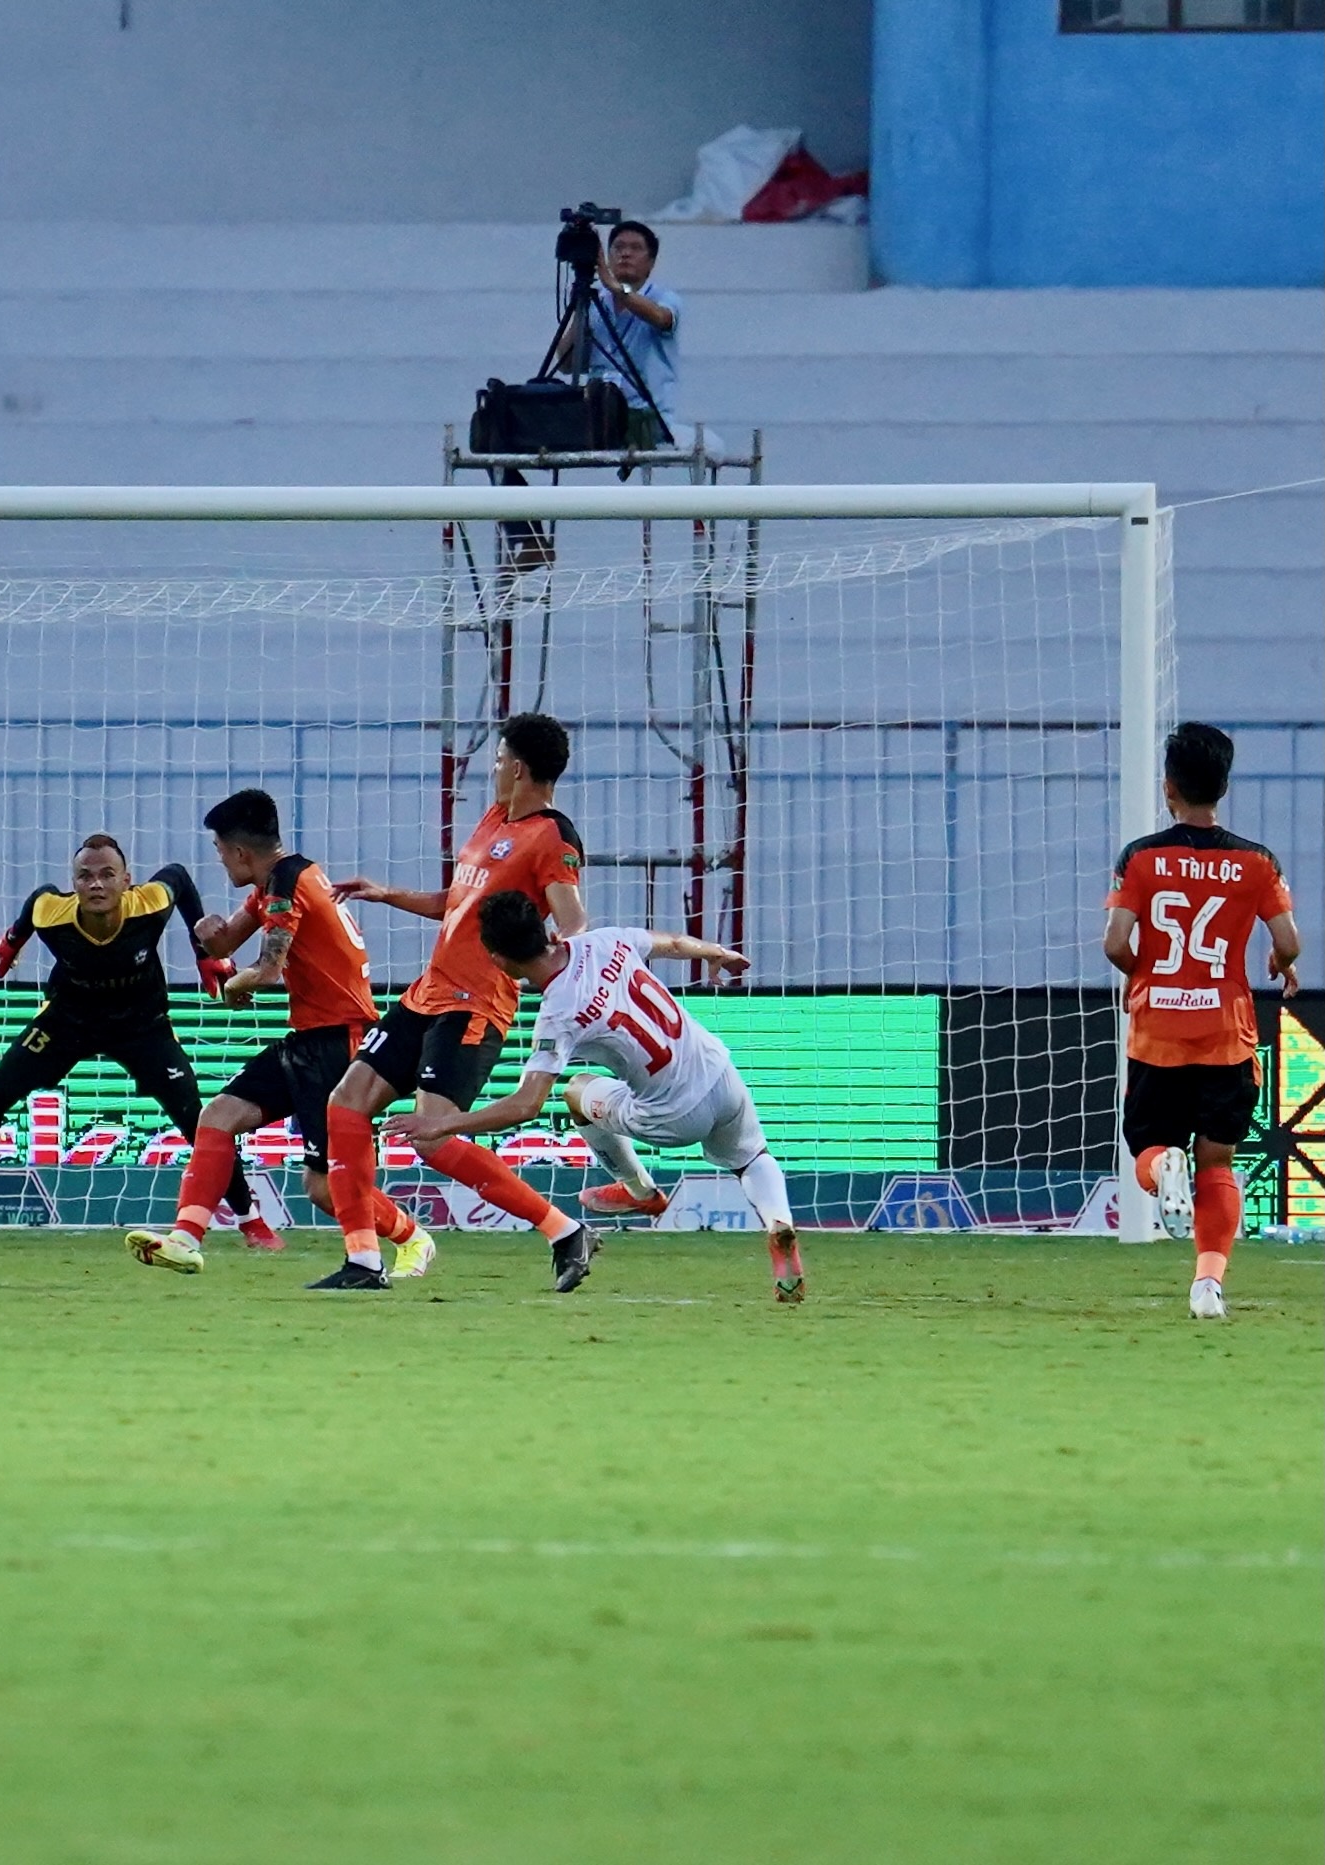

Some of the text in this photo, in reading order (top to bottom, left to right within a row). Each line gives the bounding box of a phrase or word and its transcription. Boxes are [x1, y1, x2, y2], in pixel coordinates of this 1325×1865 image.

[1154, 857, 1173, 876] N.
[1207, 859, 1244, 883] LỘC
[1150, 890, 1229, 979] 54
[573, 986, 610, 1030] Ngọc
[1154, 992, 1214, 1007] muRata
[606, 968, 683, 1077] 10
[22, 1027, 51, 1053] 13
[357, 1027, 389, 1054] 91
